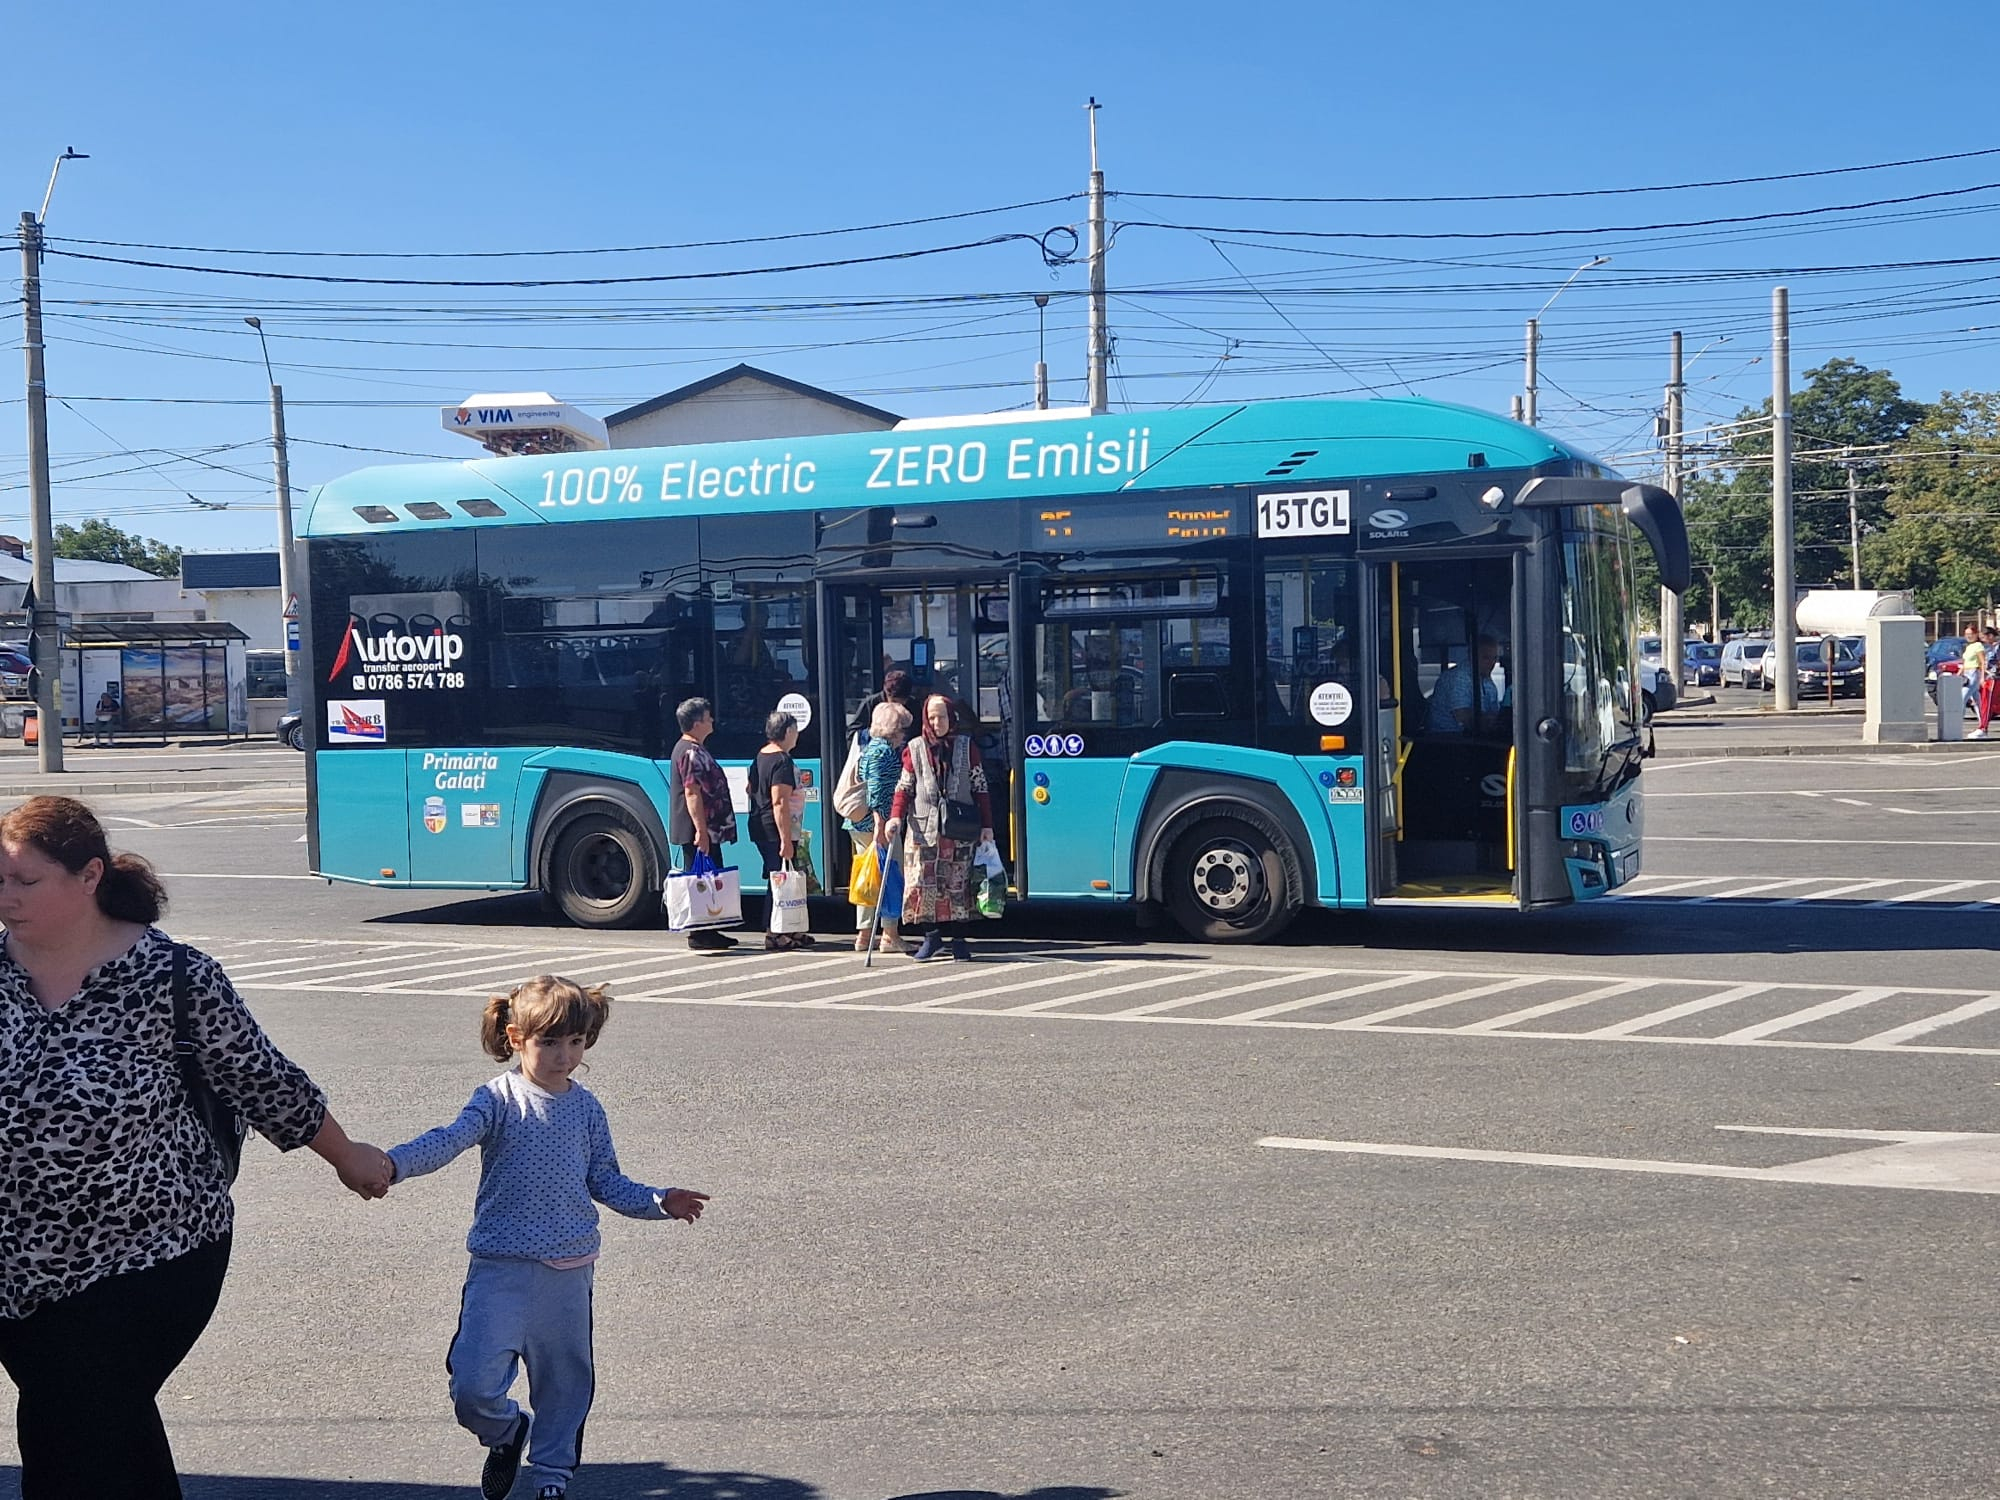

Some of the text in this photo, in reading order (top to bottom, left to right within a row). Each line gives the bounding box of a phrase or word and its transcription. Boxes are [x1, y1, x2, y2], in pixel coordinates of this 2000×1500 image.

[478, 409, 560, 424] VIM engineering
[866, 427, 1150, 489] ZERO Emisii
[538, 453, 816, 508] 100% Electric
[1260, 496, 1347, 530] 15TGL
[1369, 530, 1409, 539] SOLARIS
[329, 619, 463, 680] Autovip
[363, 662, 442, 673] transfer aeroport
[368, 672, 465, 690] 0786 574 788
[423, 752, 499, 770] Primăria
